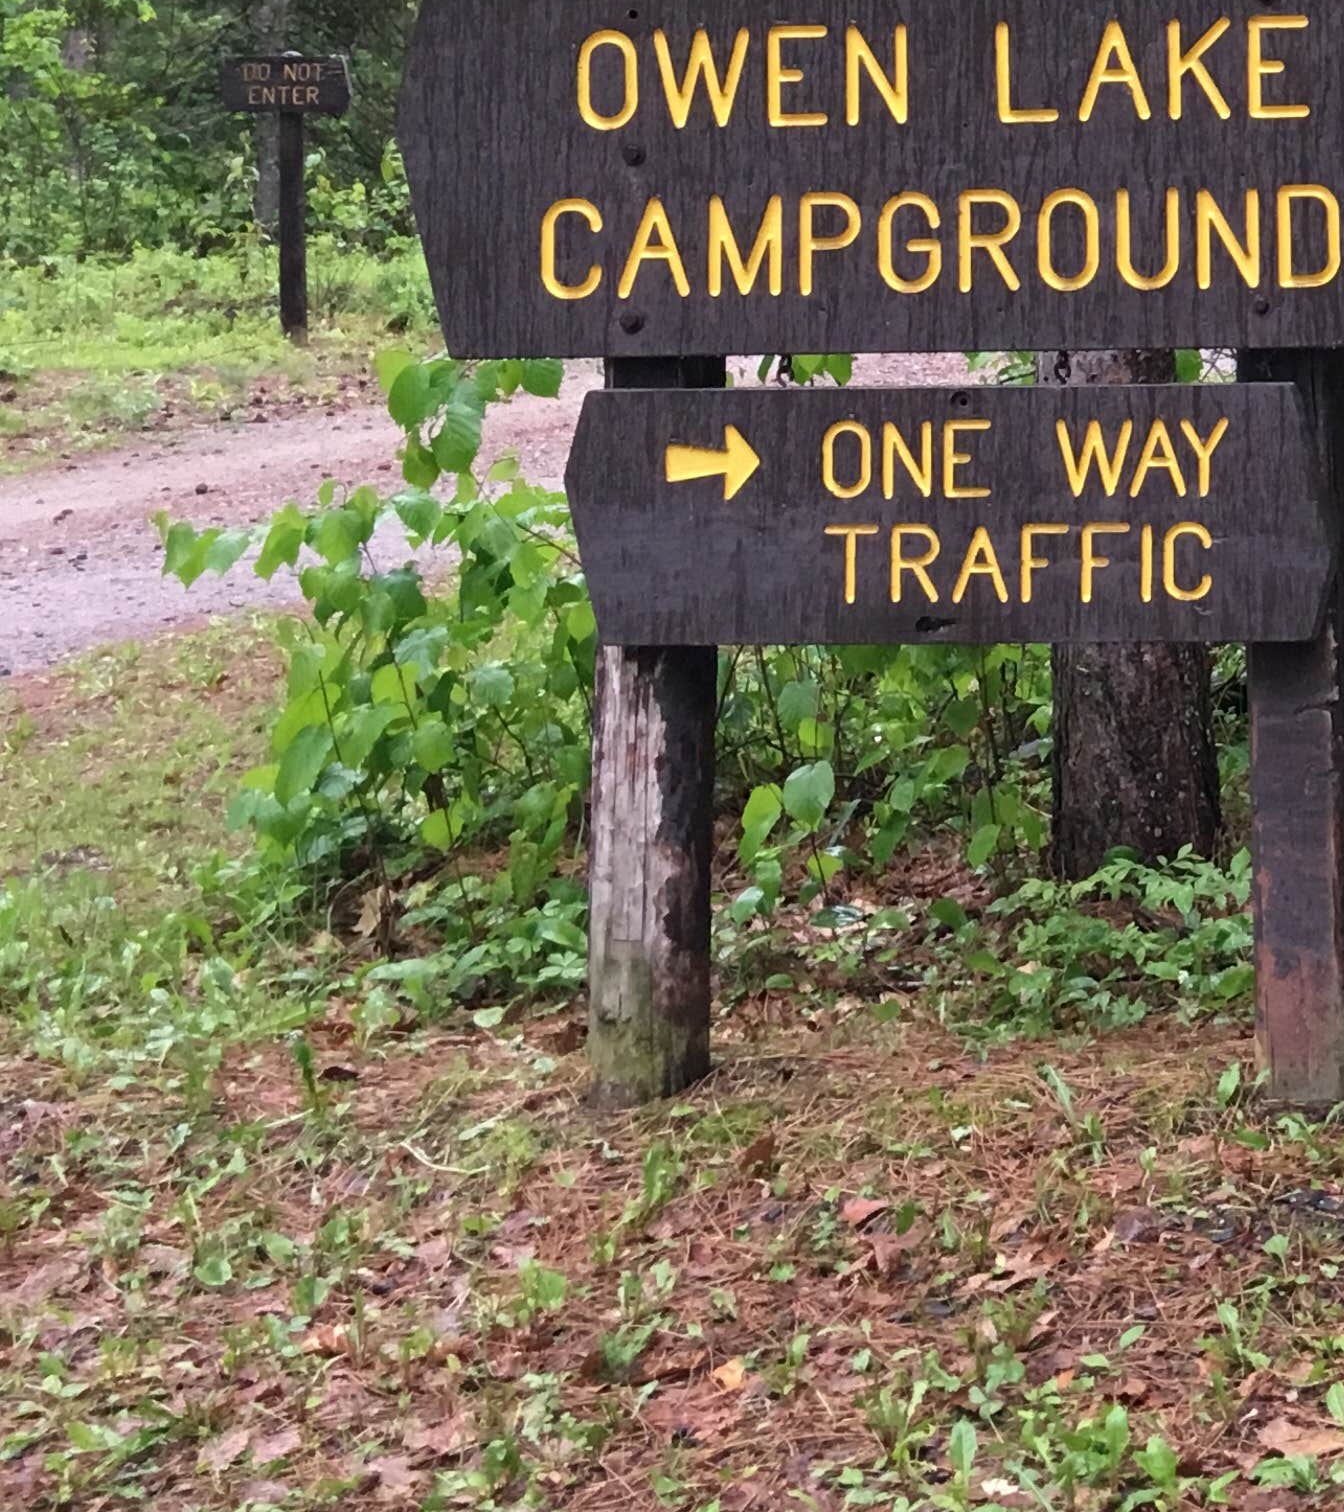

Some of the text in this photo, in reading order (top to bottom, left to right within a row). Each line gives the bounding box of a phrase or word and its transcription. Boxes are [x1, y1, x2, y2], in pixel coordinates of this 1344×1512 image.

[241, 63, 323, 82] DO NOT
[248, 86, 321, 105] ENTER
[576, 14, 1311, 131] OWEN LAKE
[540, 183, 1341, 300] CAMPGROUND
[821, 417, 1227, 499] ONE WAY
[825, 521, 1213, 602] TRAFFIC
